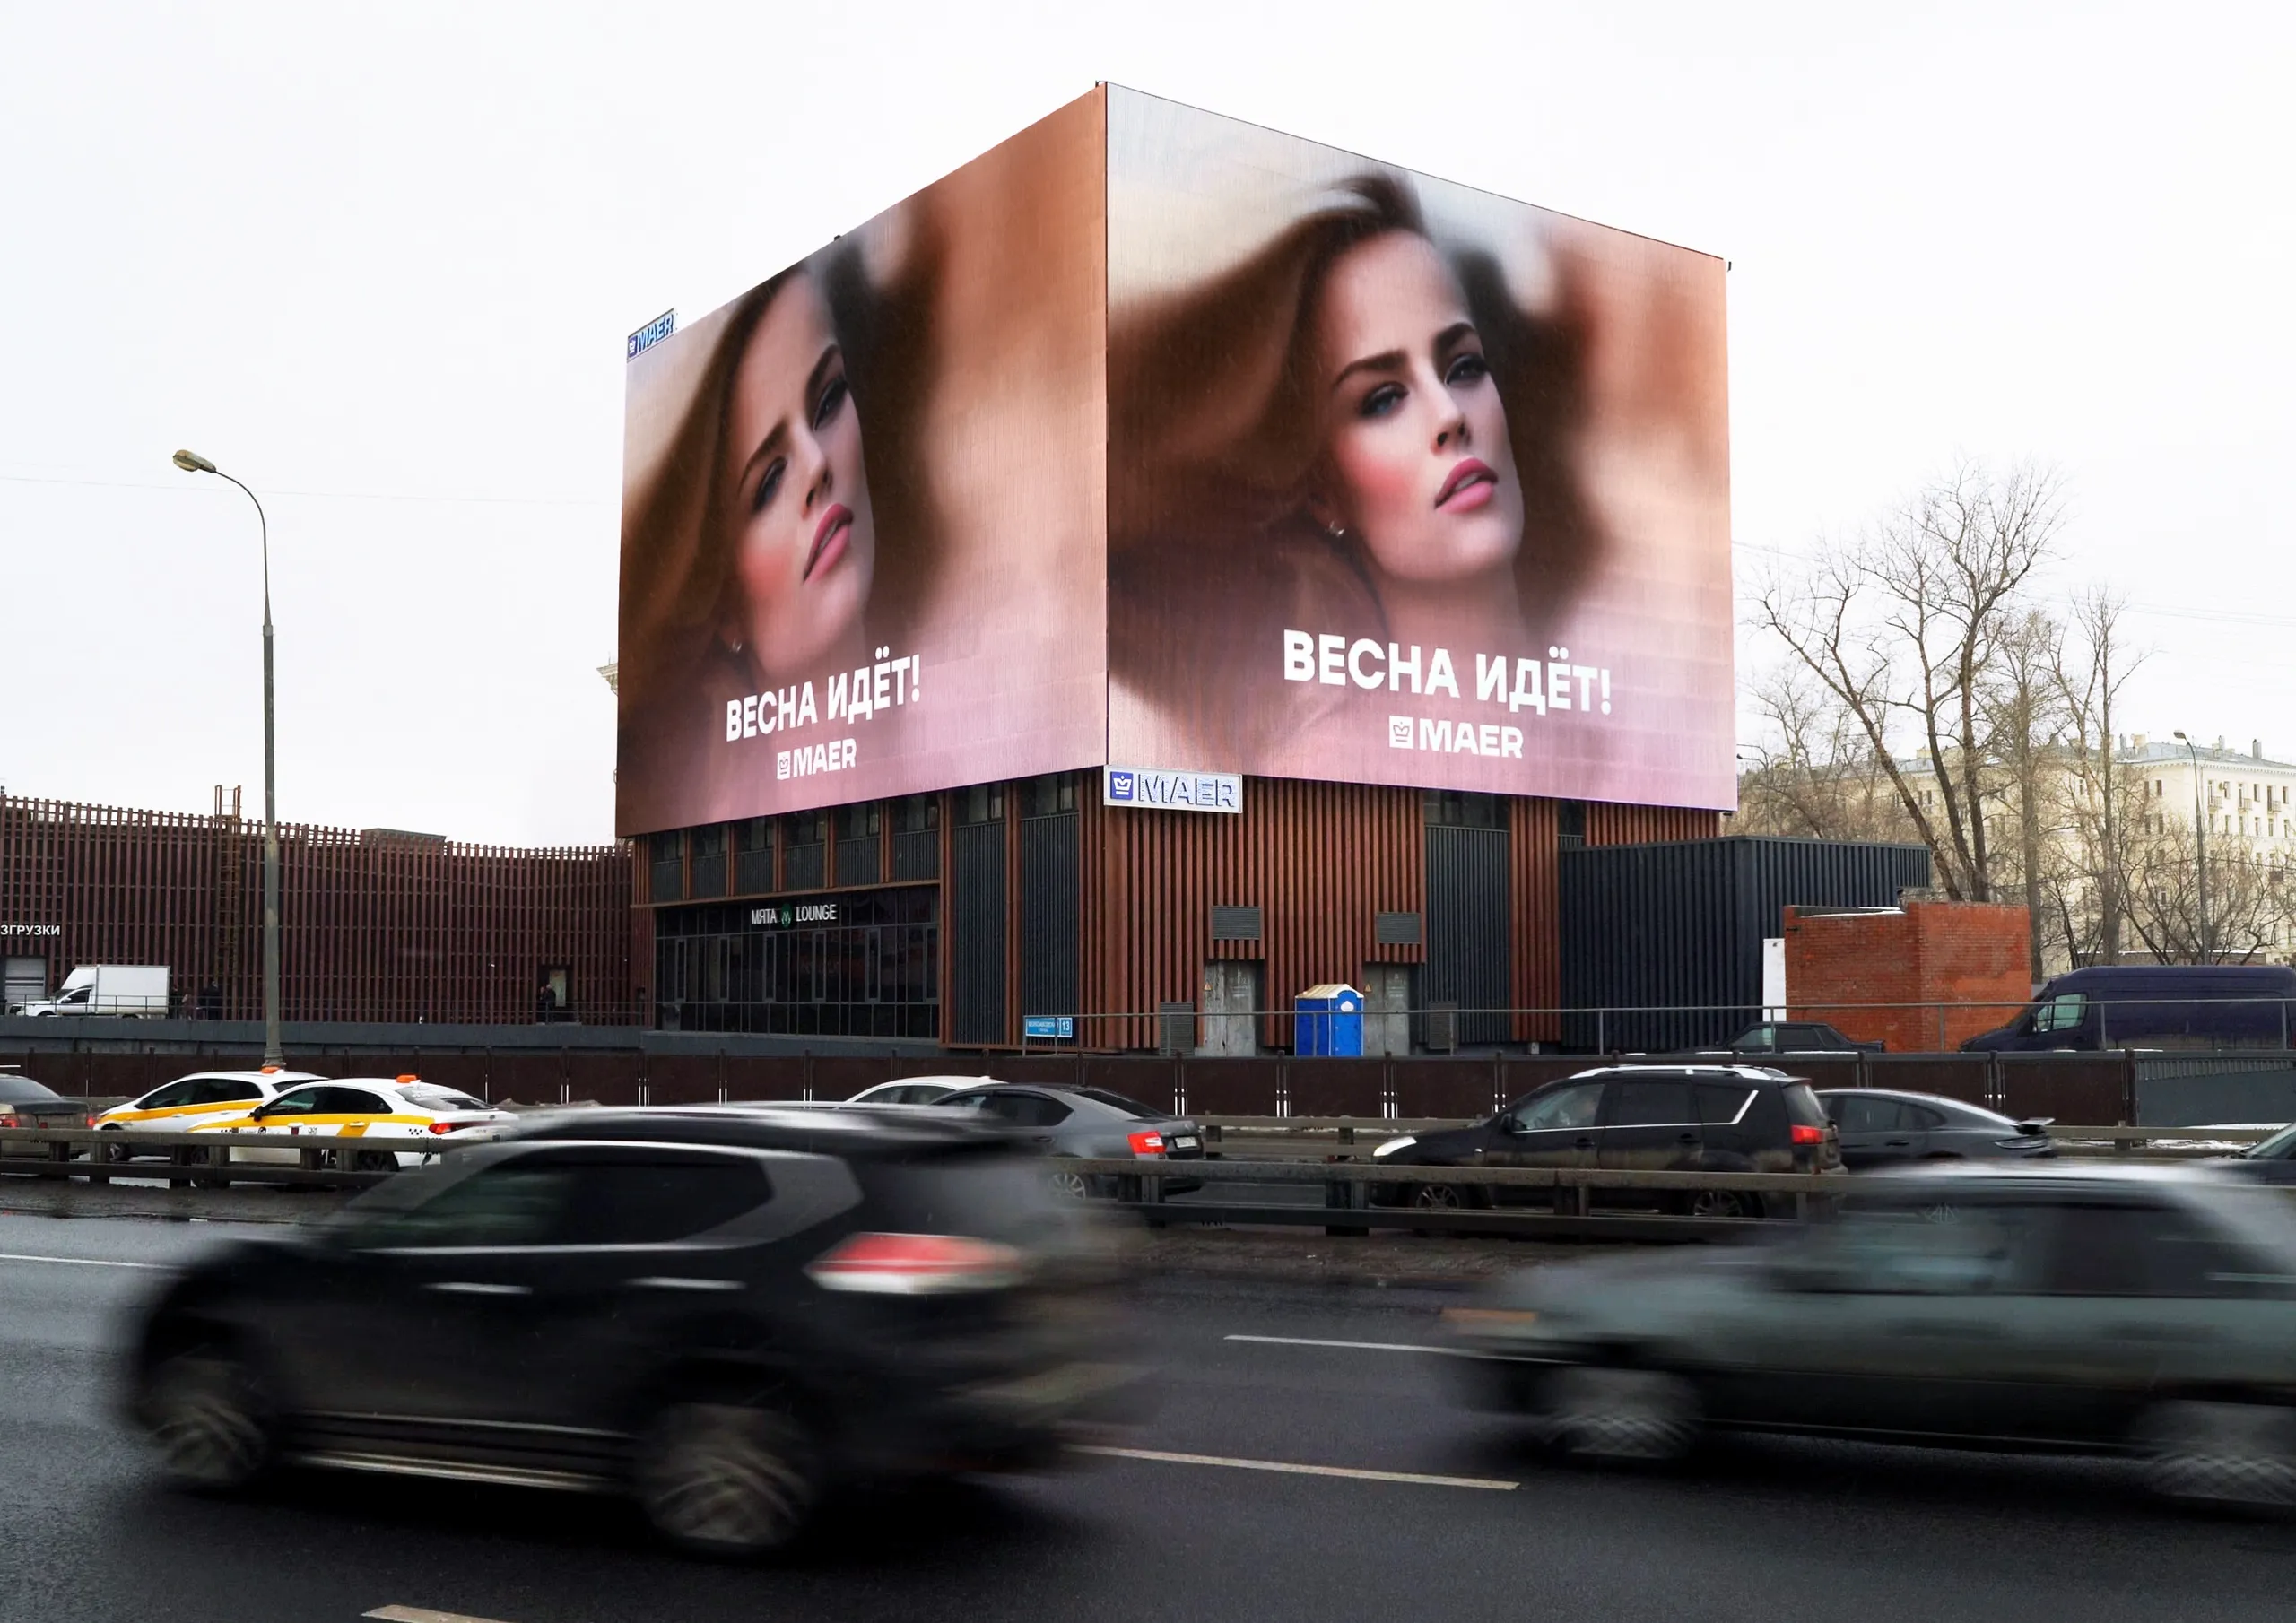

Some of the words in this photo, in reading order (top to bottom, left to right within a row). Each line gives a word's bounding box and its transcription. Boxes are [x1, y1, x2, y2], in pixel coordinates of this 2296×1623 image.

[638, 314, 674, 352] MAER
[1283, 629, 1460, 699] ВЕСНА
[1476, 646, 1611, 716] ИДЁТ!
[726, 681, 818, 742] ВЕСНА
[828, 645, 920, 725] ИДЁТ!
[793, 738, 857, 778] MAER
[1419, 718, 1524, 759] MAER
[1138, 773, 1236, 808] MAER
[752, 908, 778, 924] МЯТА
[796, 904, 838, 922] LOUNGE
[1062, 1020, 1070, 1031] 13
